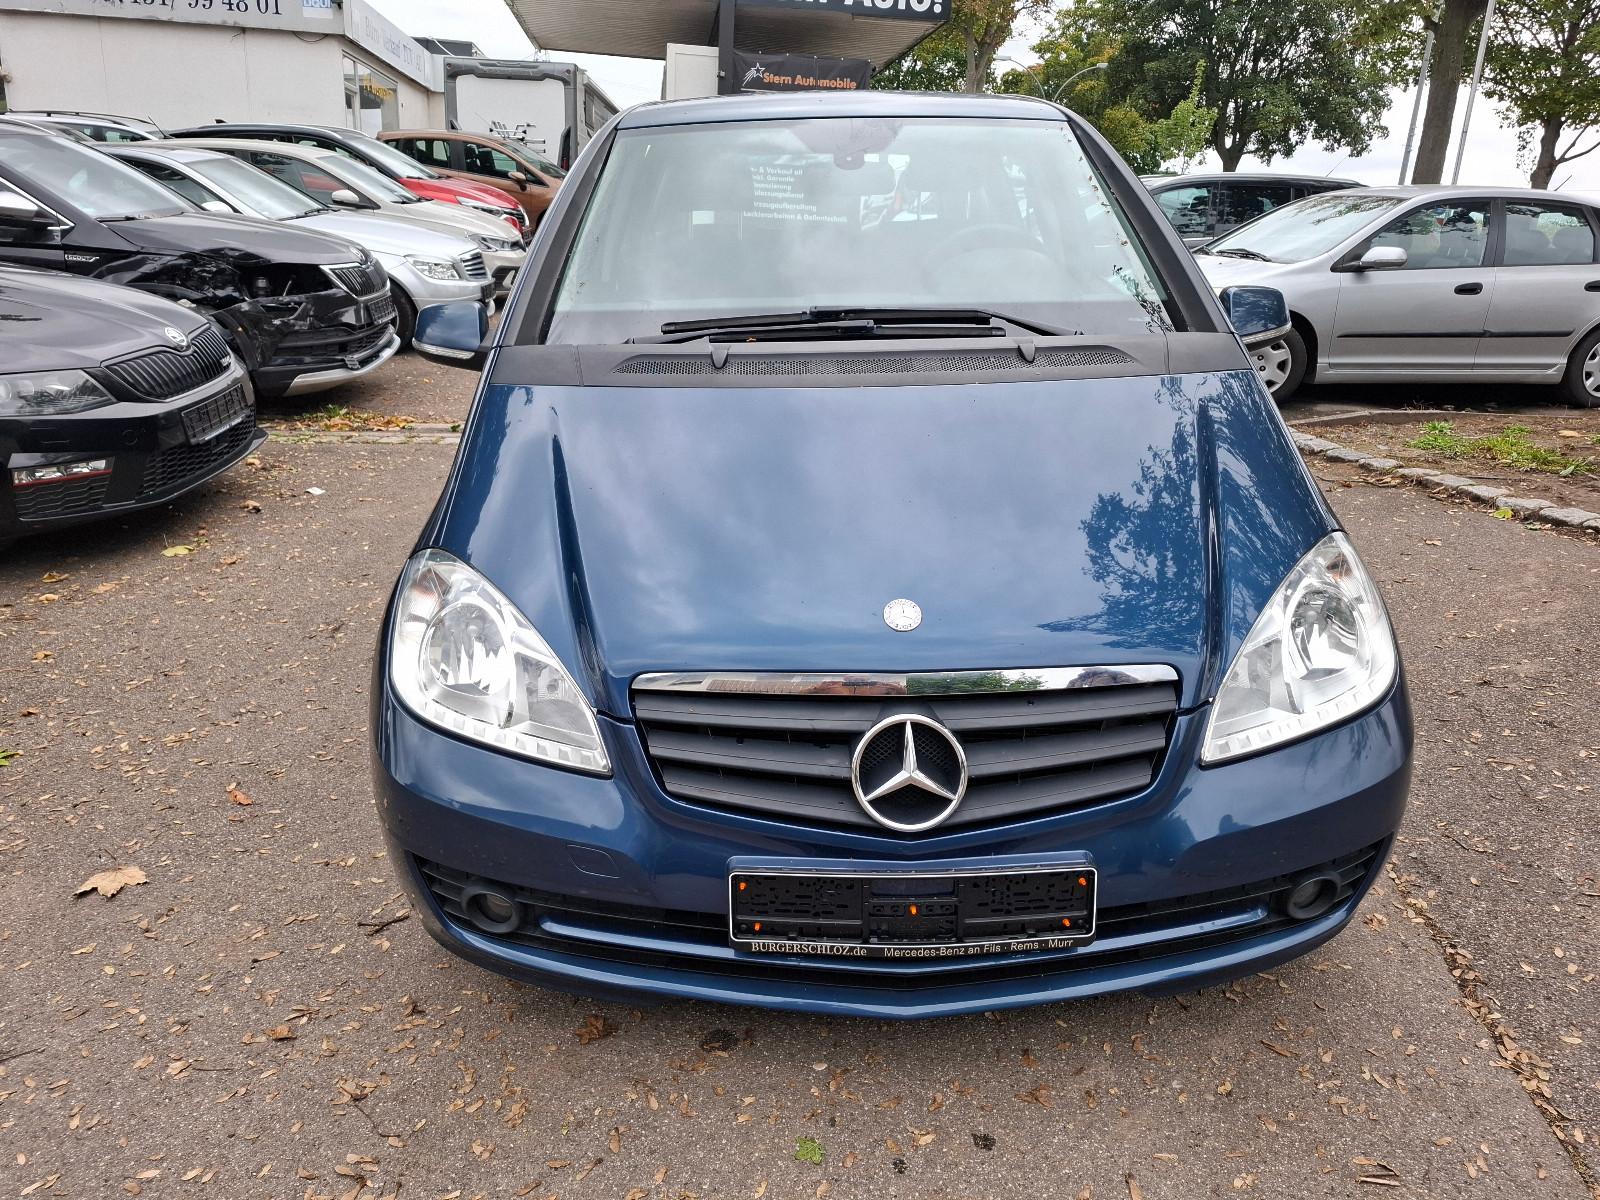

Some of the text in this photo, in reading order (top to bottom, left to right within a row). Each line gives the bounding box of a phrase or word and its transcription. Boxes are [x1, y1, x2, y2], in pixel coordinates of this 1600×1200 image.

[763, 72, 857, 89] Stern Automobile
[766, 174, 794, 182] Garantie
[751, 942, 867, 956] BURGERSCHLOZ.de
[884, 938, 1074, 958] Mercedes-Benz an Fils Rems Murr
